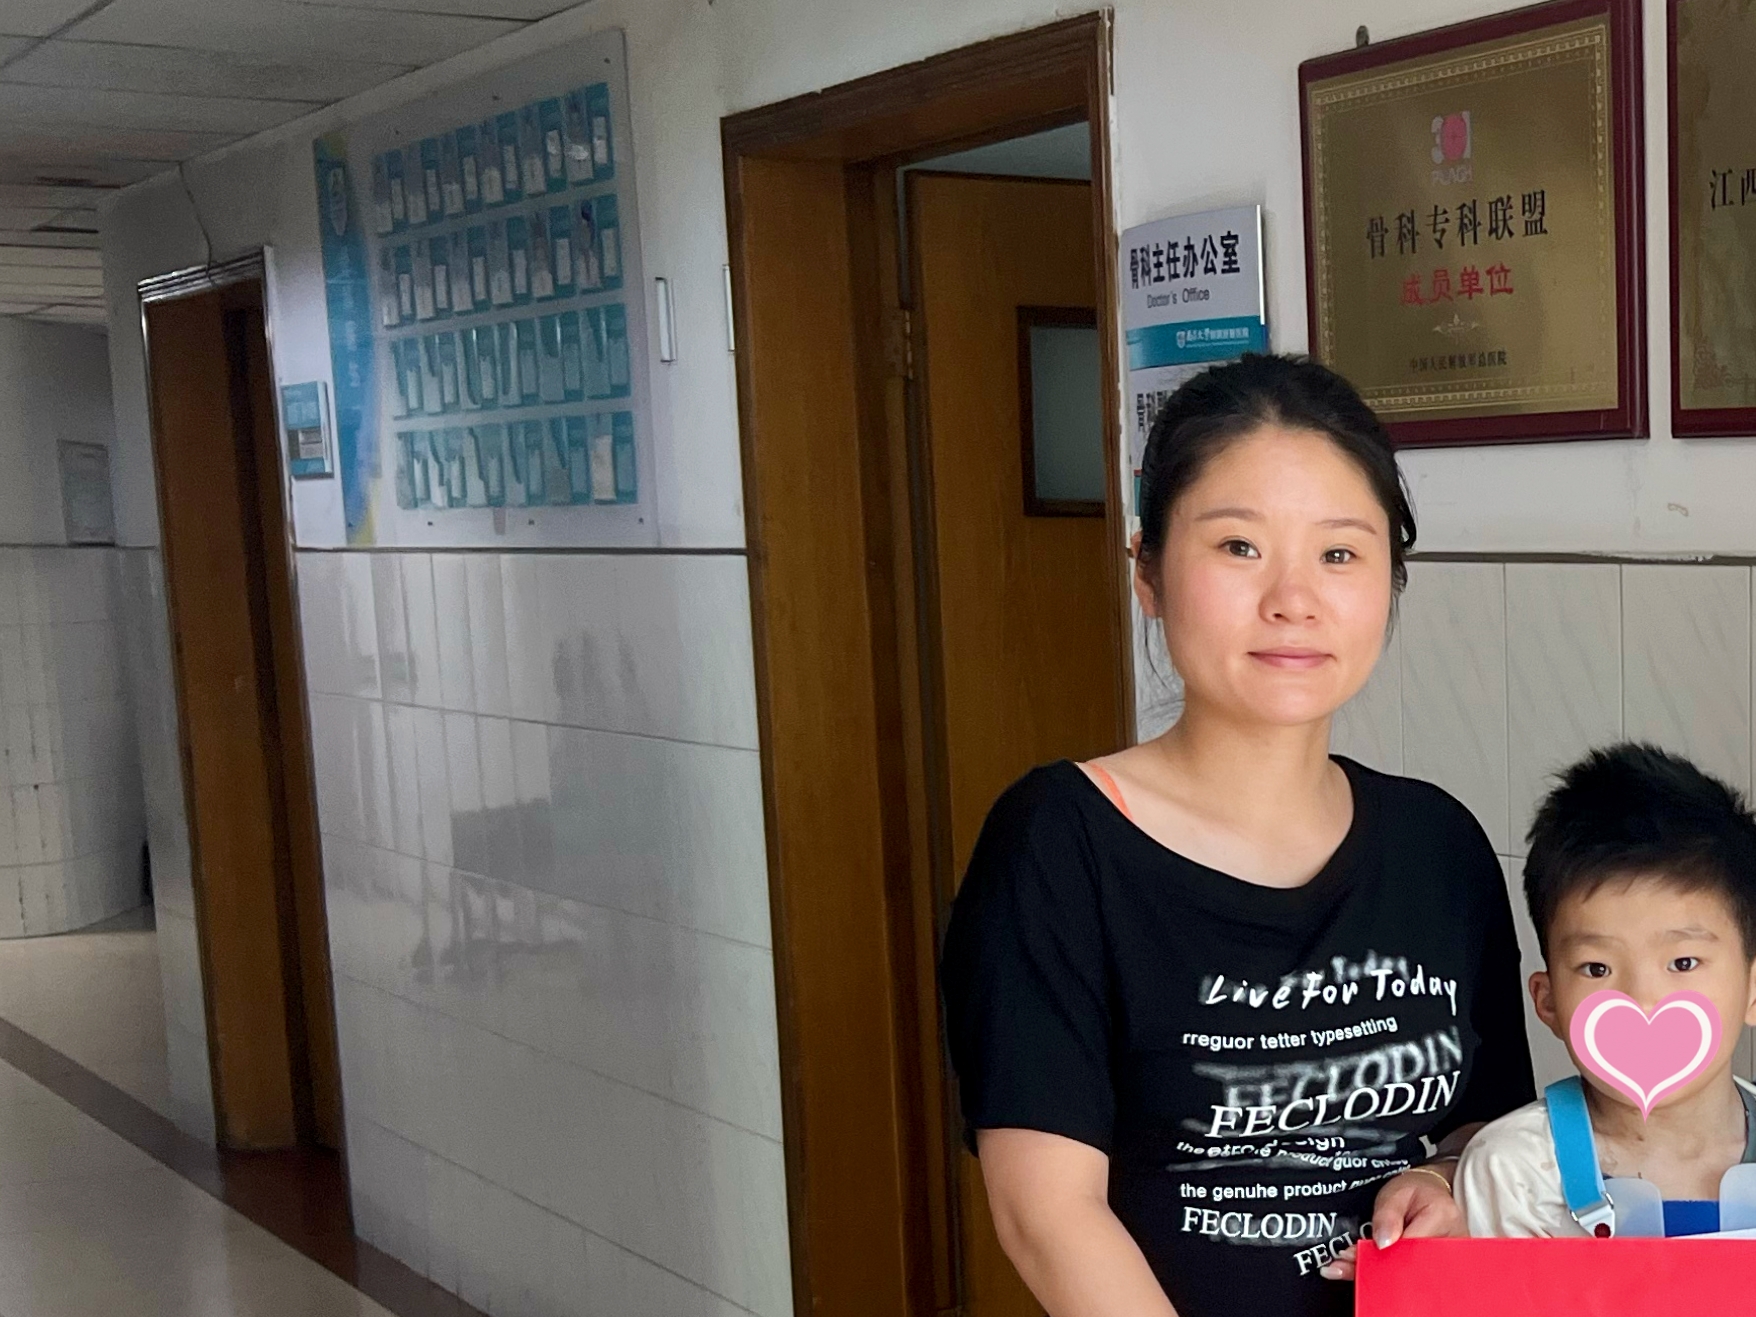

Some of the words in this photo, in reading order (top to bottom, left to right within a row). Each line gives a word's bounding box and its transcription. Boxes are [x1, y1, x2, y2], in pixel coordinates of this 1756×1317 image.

[1365, 188, 1550, 260] 骨科专科联盟
[1129, 230, 1241, 290] 骨科主任办公室
[1181, 287, 1210, 304] Office
[1400, 261, 1514, 308] 成员单位
[1204, 973, 1291, 1010] Live
[1301, 971, 1360, 1011] For
[1370, 963, 1459, 1017] Today
[1310, 1015, 1399, 1048] typesetting
[1204, 1070, 1461, 1140] FECLODIN
[1179, 1182, 1208, 1199] the
[1283, 1179, 1348, 1201] product
[1180, 1205, 1338, 1240] FECLODIN
